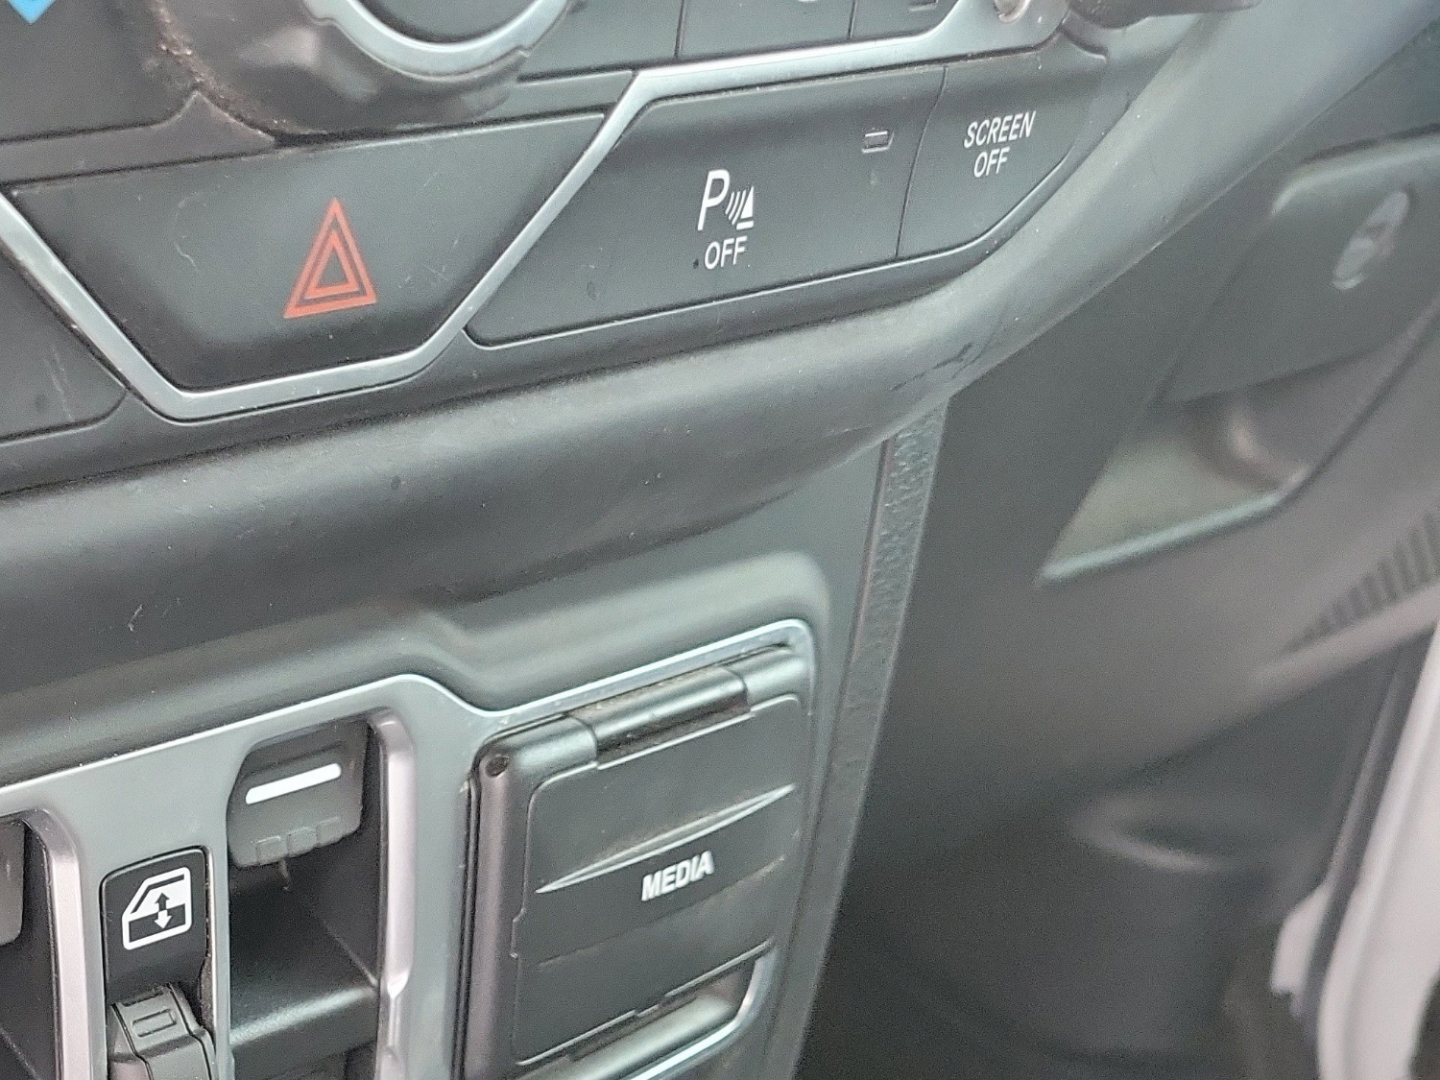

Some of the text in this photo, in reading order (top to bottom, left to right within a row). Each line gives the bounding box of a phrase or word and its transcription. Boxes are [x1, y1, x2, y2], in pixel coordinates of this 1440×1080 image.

[963, 110, 1037, 149] SCREEN
[973, 146, 1010, 178] OFF
[697, 169, 730, 231] P
[704, 235, 748, 270] OFF
[641, 850, 715, 902] MEDIA
